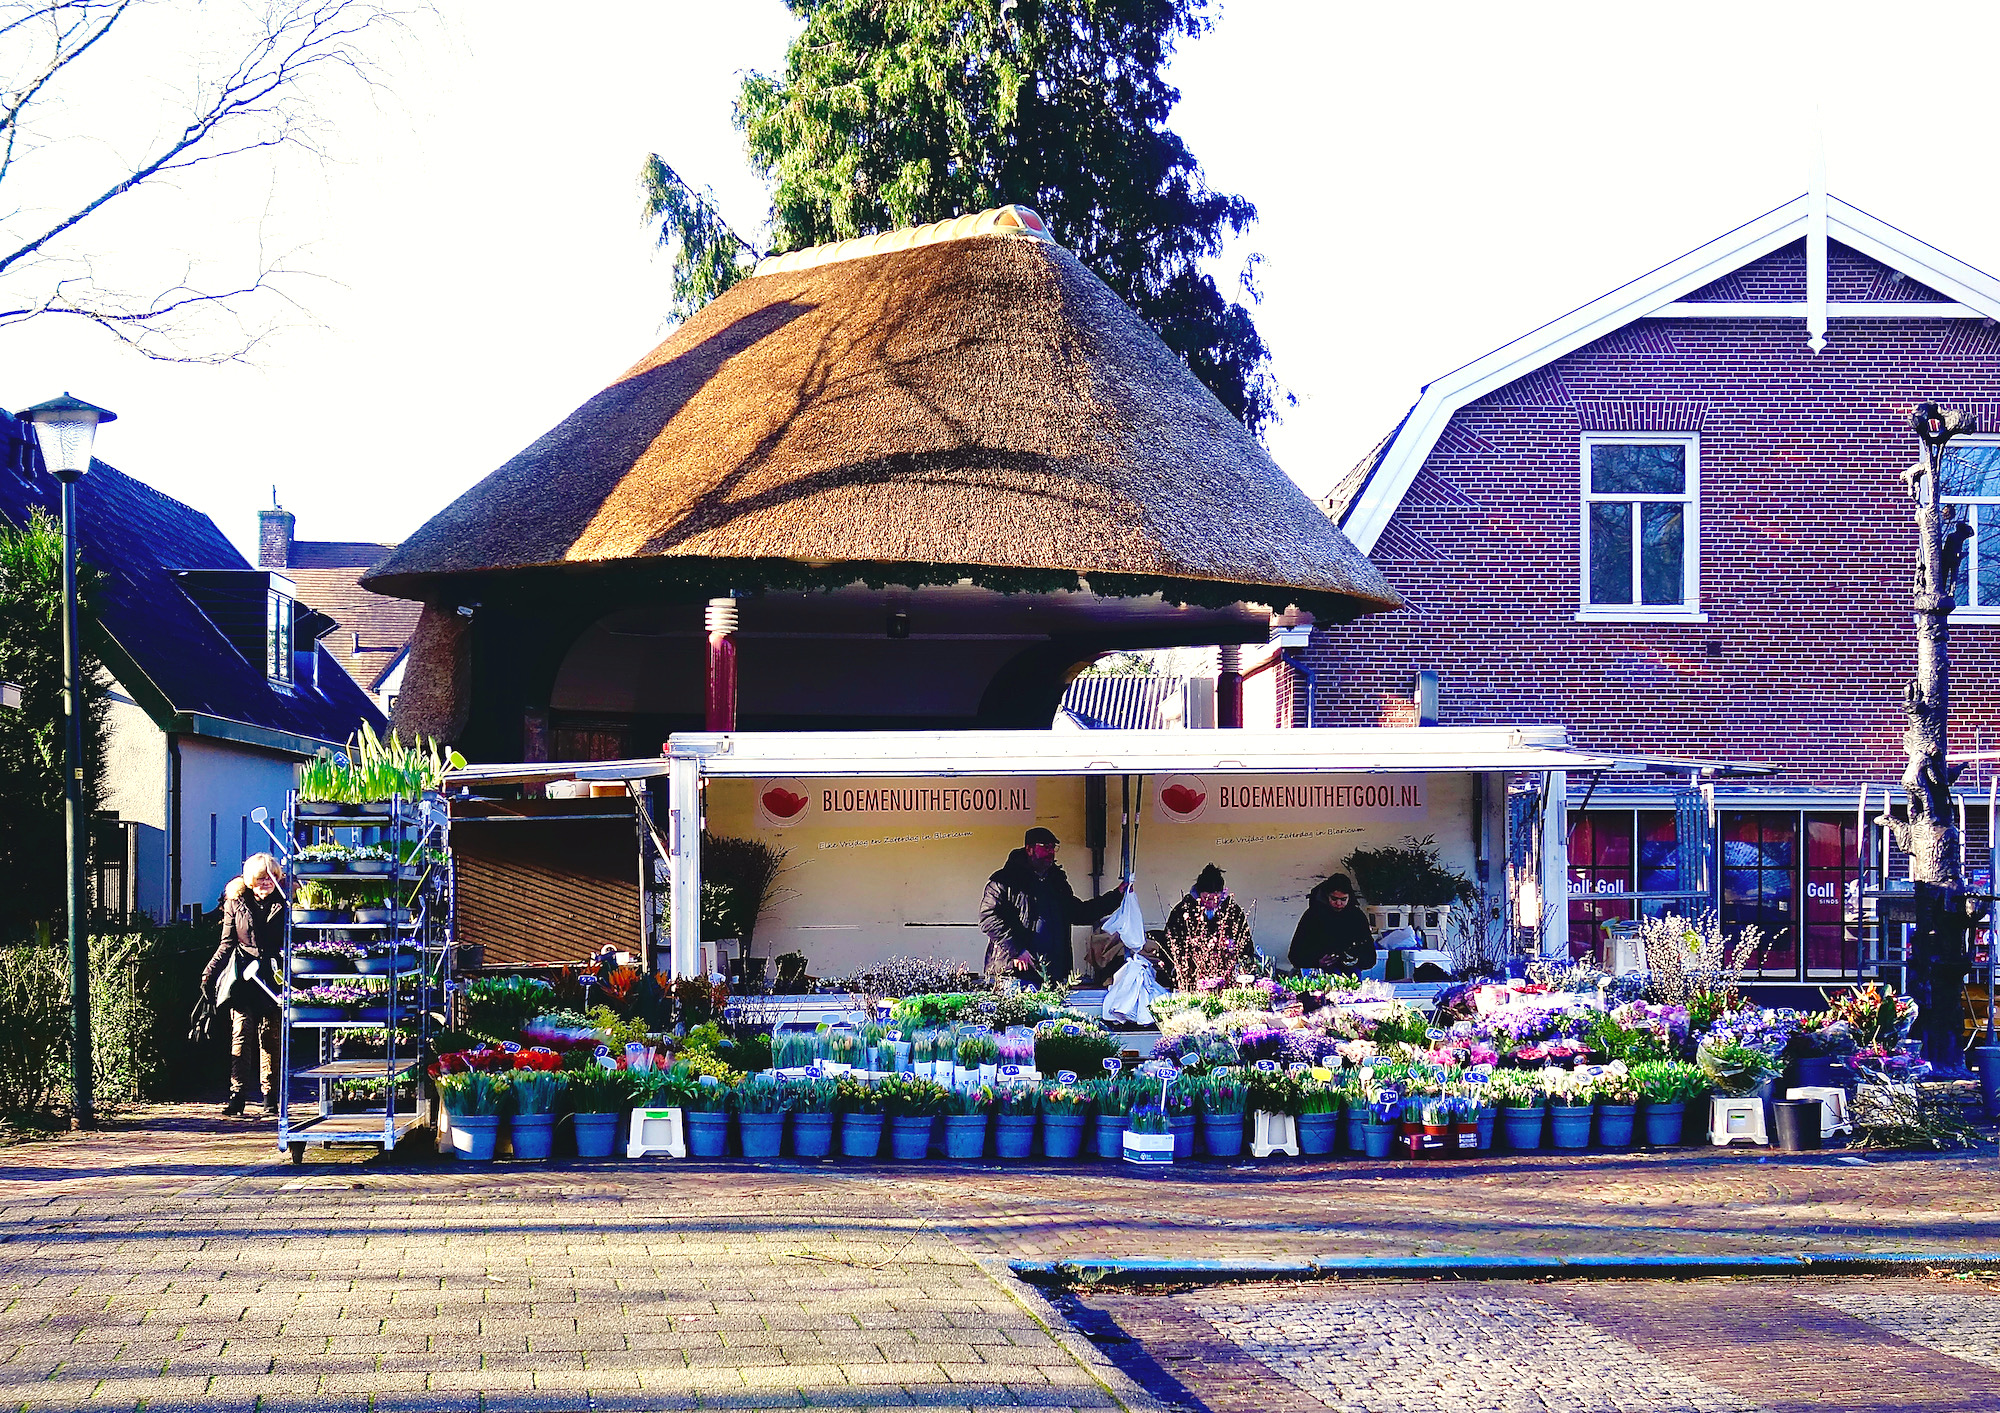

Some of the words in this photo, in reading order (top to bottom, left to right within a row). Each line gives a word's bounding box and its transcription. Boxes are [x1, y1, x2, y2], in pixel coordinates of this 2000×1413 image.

[822, 788, 1031, 812] BLOEMENUITHETGOOI.NL
[1219, 785, 1422, 808] BLOEMENUITHETGOOI.NL
[818, 841, 838, 850] Elke
[839, 838, 869, 849] Vrijdag
[883, 834, 920, 844] Zaterdag
[933, 830, 974, 840] Blaricum
[1216, 838, 1235, 846] Elke
[1236, 836, 1265, 846] Vrijdag
[1278, 831, 1314, 841] Zaterdag
[1327, 827, 1366, 836] Blaricum
[1566, 878, 1590, 894] Gall
[1597, 878, 1624, 894] Gall
[1807, 882, 1834, 898] Gall
